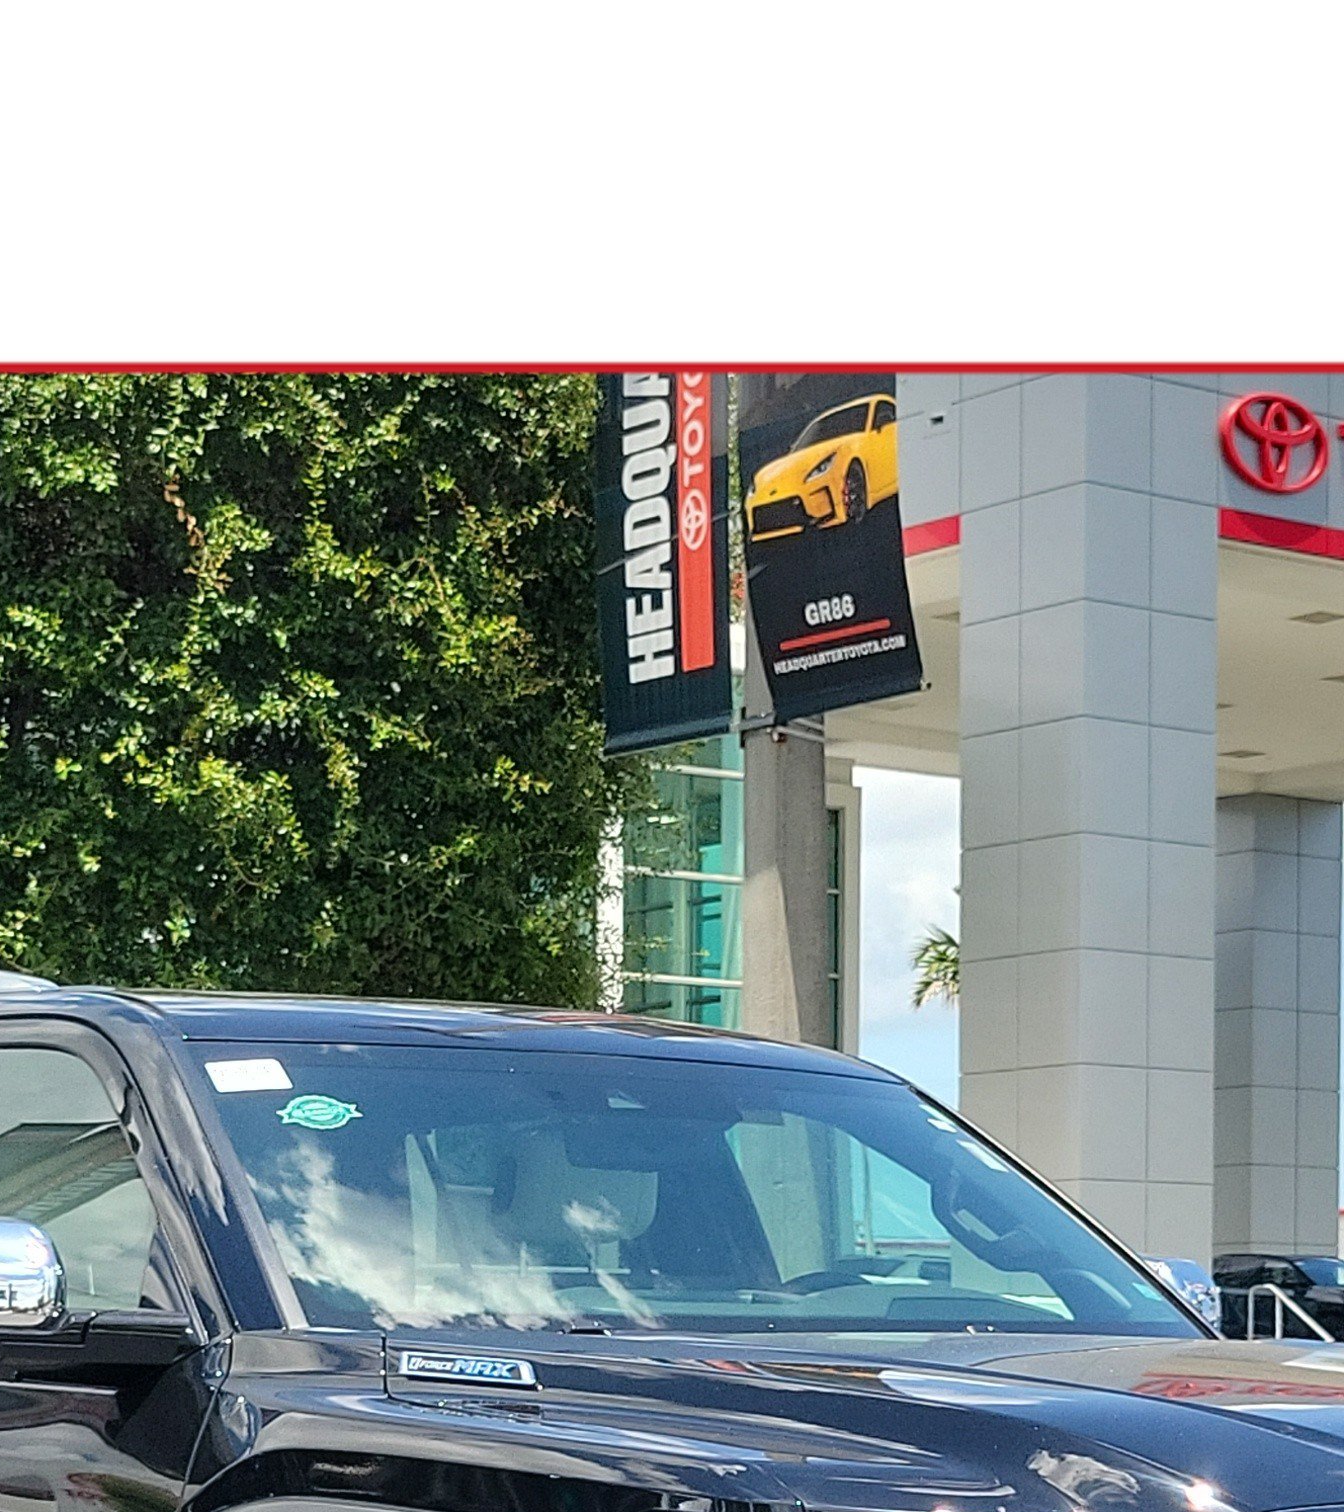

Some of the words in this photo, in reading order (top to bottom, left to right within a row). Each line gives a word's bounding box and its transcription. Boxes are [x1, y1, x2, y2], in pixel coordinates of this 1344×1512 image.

[804, 594, 856, 626] GR86
[773, 634, 907, 676] HEADQUARTERTOYOTA.COM
[451, 1359, 516, 1379] MAX
